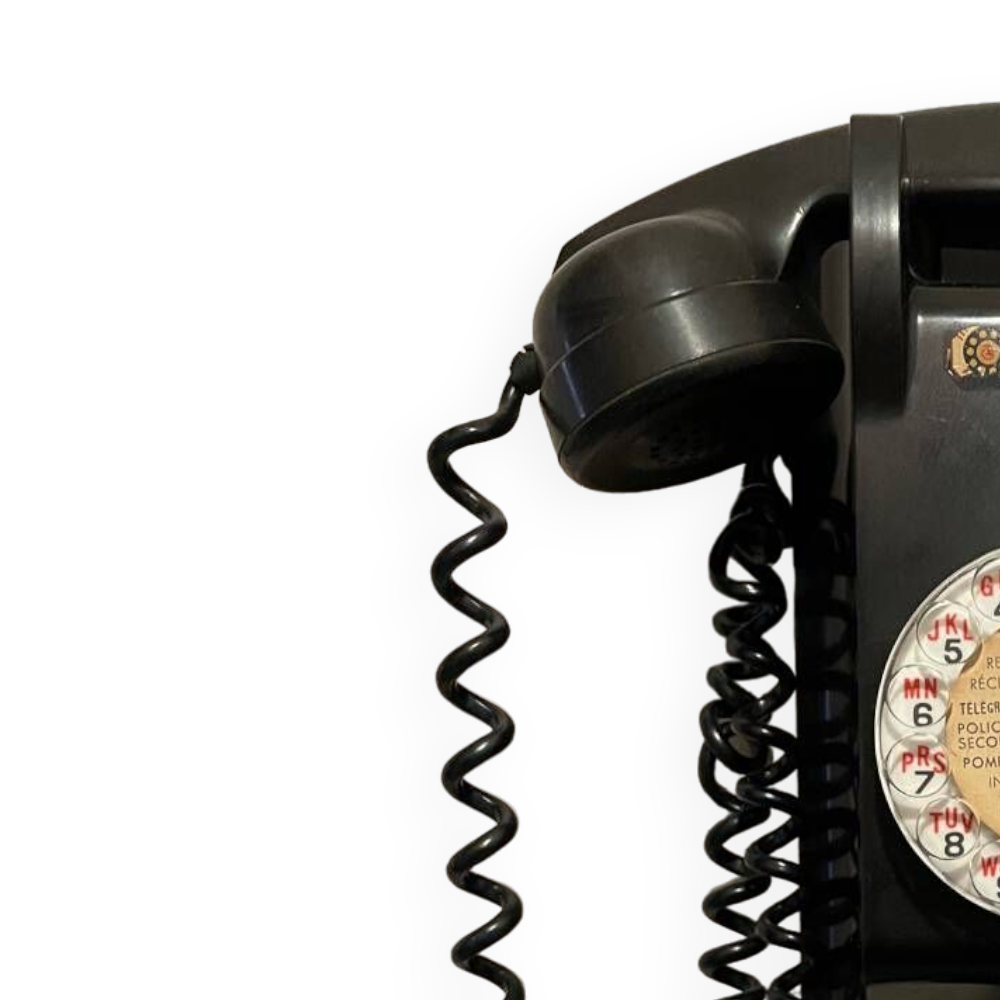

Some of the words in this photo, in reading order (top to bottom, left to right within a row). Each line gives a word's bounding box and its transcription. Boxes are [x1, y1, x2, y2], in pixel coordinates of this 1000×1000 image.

[927, 613, 975, 641] JKL
[944, 638, 964, 665] 5
[904, 678, 938, 699] MN
[912, 702, 933, 728] 6
[901, 745, 947, 774] PRS
[914, 771, 935, 795] 7
[929, 807, 974, 834] TUV
[943, 831, 965, 858] 8
